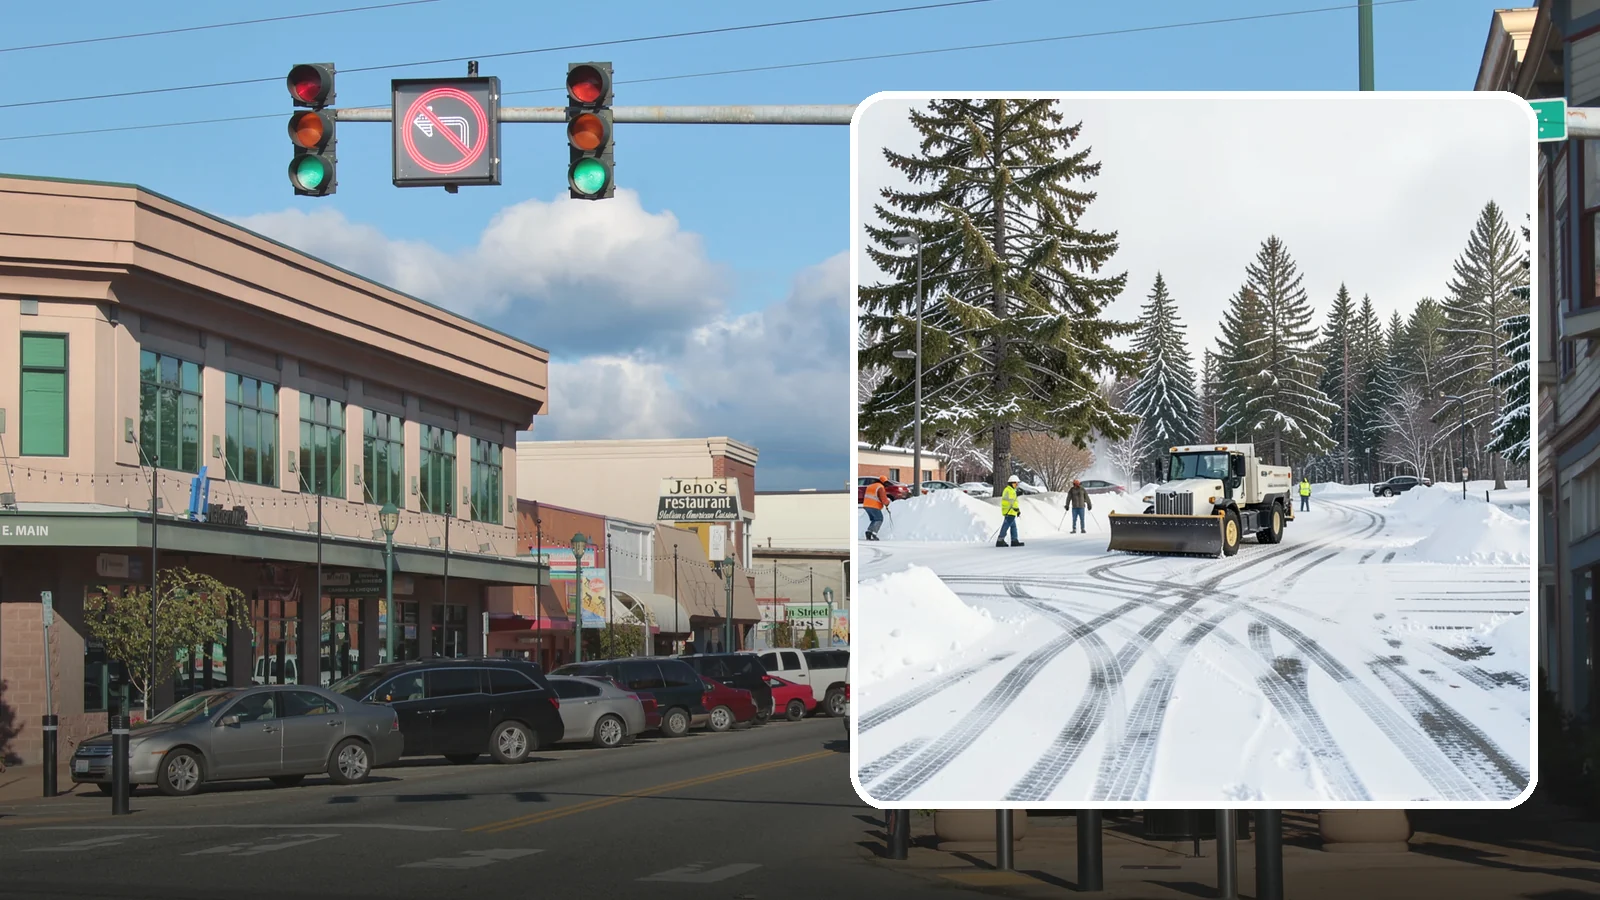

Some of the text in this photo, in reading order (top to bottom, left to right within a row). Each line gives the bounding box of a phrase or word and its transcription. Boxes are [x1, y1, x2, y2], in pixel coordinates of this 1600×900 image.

[670, 480, 727, 494] Jeno's
[665, 496, 731, 509] restaurant
[658, 510, 681, 519] Italian
[686, 510, 714, 520] American
[715, 510, 738, 519] Cuisine
[2, 525, 48, 536] E. MAIN
[797, 607, 828, 616] Street
[791, 619, 823, 627] lass
